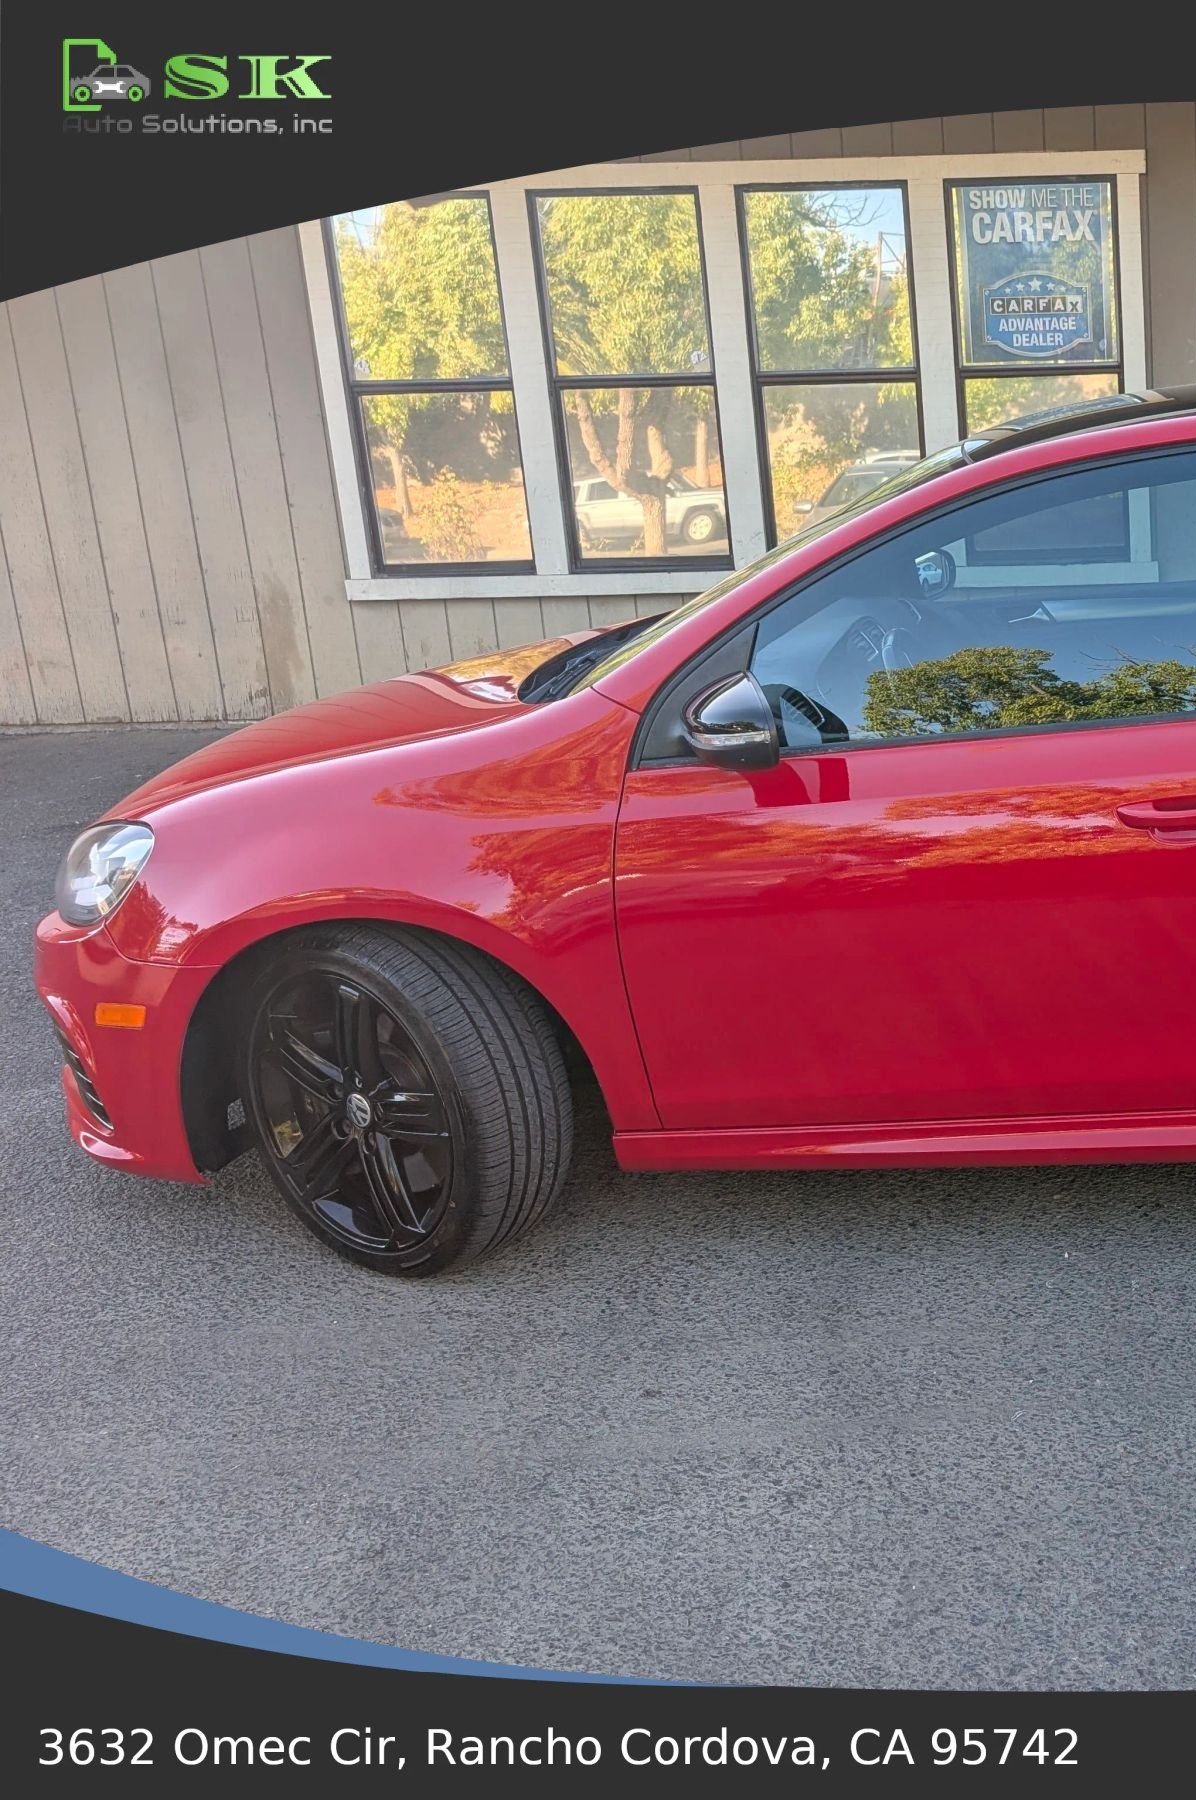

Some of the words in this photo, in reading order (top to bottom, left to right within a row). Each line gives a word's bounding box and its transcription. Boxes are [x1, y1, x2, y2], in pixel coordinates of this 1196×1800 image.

[969, 189, 1025, 210] SHOW
[1031, 189, 1057, 208] ME
[1061, 187, 1093, 207] THE
[972, 210, 1094, 244] CARFAX
[993, 298, 1082, 313] CARFAX
[998, 316, 1077, 332] ADVANTAGE
[1012, 332, 1064, 347] DEALER
